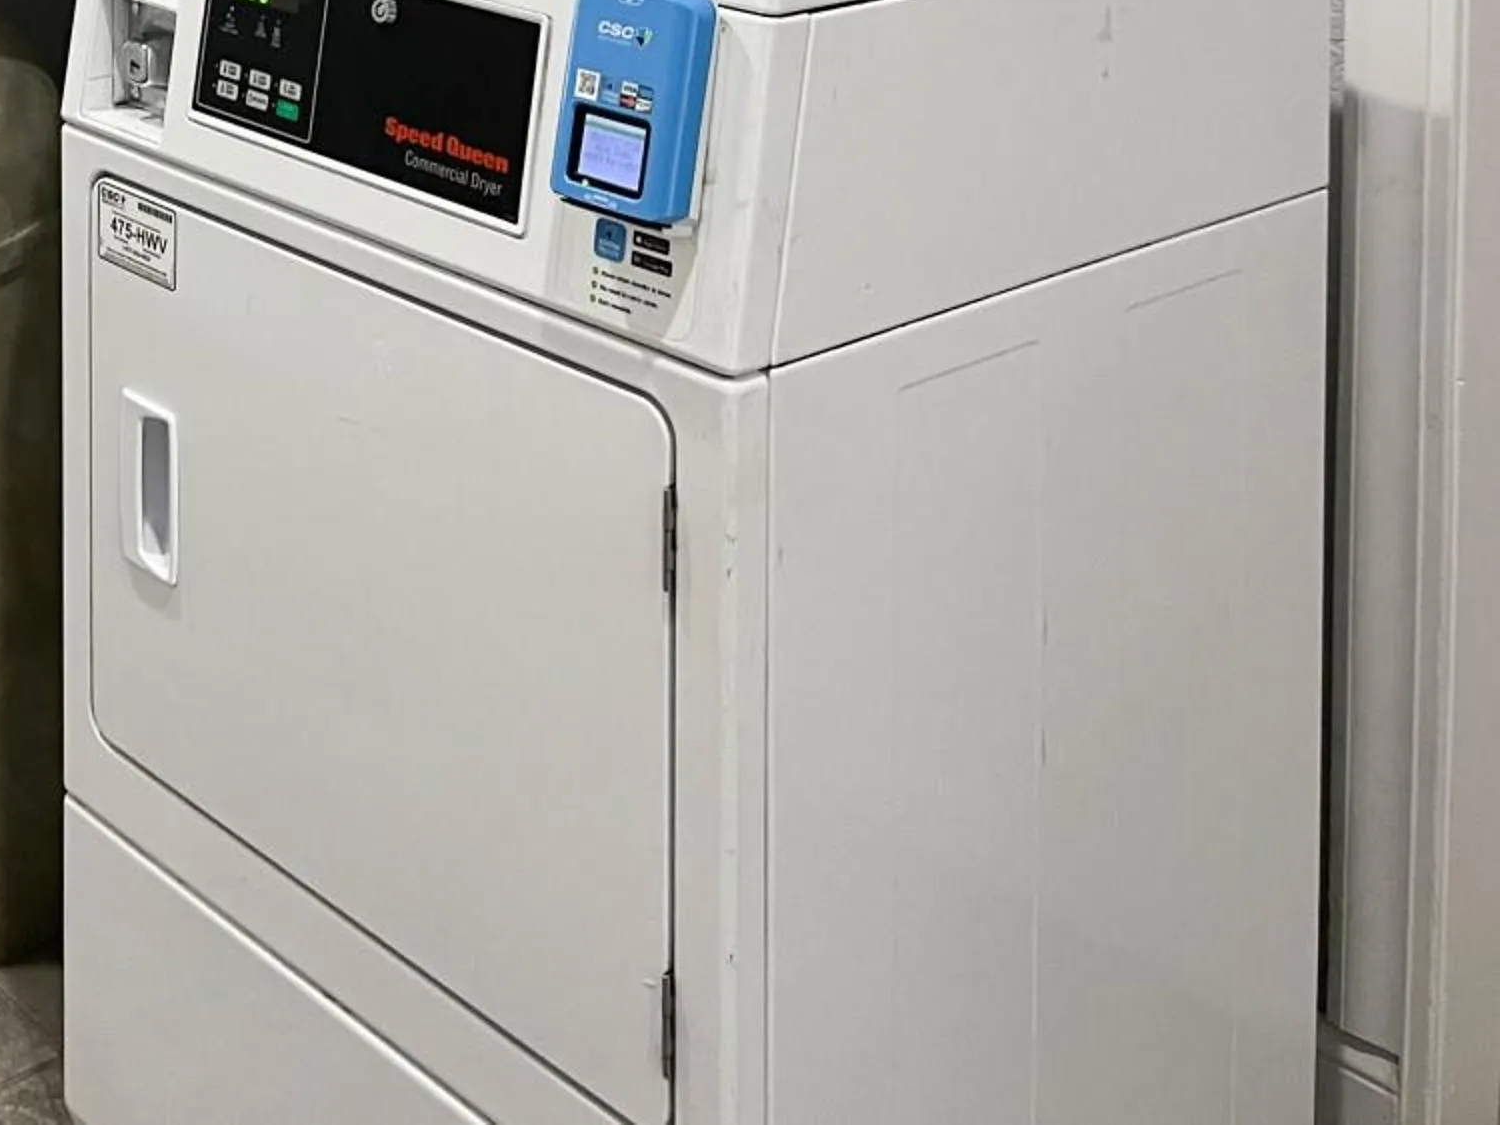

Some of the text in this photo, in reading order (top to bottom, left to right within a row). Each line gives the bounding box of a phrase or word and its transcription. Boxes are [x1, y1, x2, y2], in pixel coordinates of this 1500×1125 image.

[598, 19, 635, 40] CSC
[384, 116, 509, 174] Speed Queen
[404, 149, 503, 196] Commercial Dryer
[110, 217, 168, 254] 475-HWV
